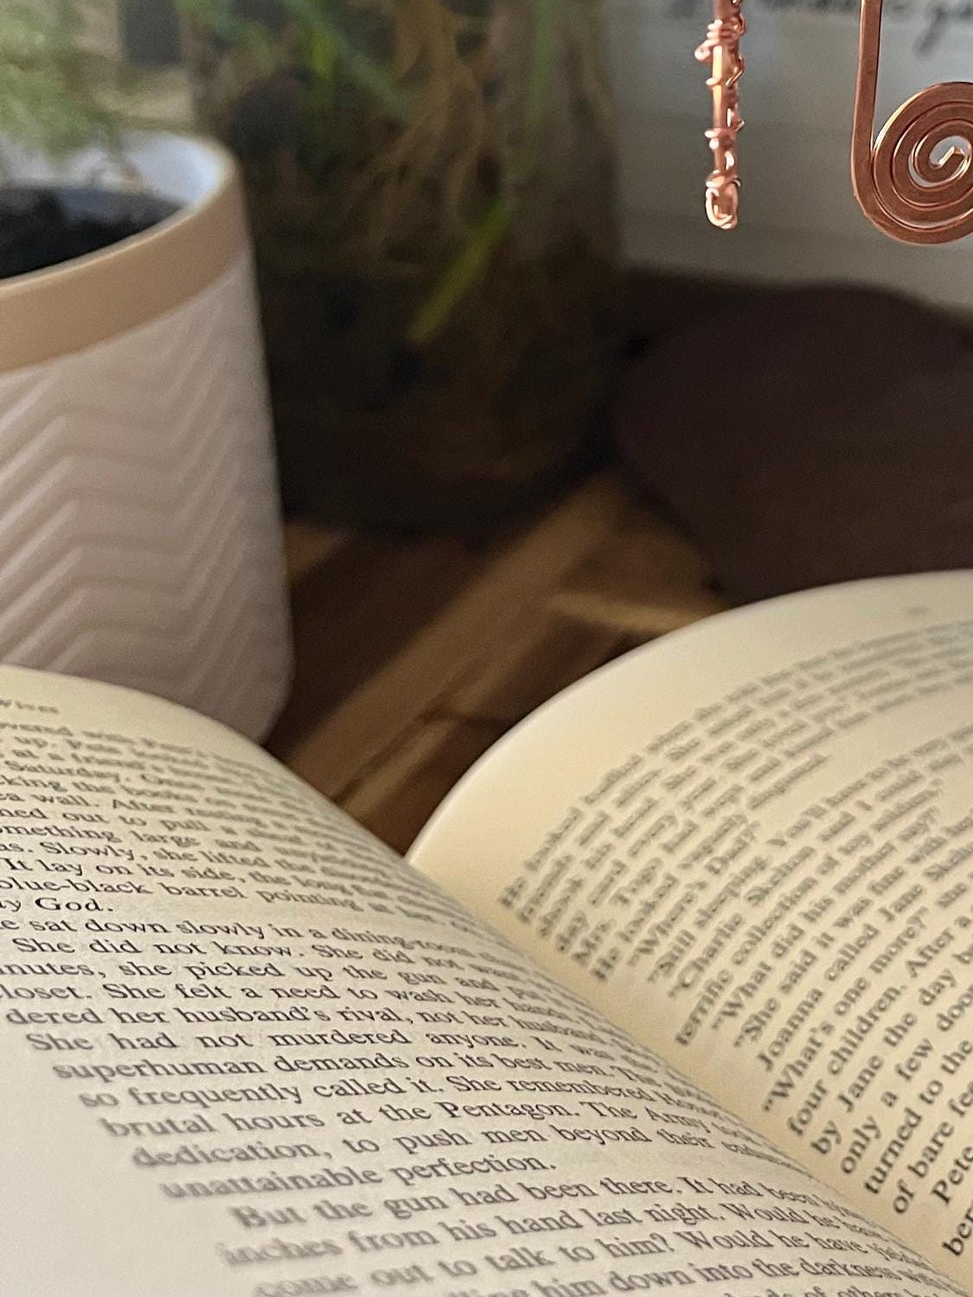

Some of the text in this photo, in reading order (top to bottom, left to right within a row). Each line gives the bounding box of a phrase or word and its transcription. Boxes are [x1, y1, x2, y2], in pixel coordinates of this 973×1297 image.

[40, 841, 148, 861] Slowly,
[35, 859, 245, 883] lay on its side,
[35, 897, 114, 912] God.
[159, 882, 364, 912] barrel pointing
[29, 918, 304, 939] sat down slowly in
[12, 938, 364, 960] She did not know. She
[118, 962, 447, 985] she picked up the gun
[102, 983, 501, 1009] She felt need to wash her
[6, 1006, 506, 1028] dered her rival, not her
[757, 988, 825, 1072] Joanna
[827, 984, 908, 1075] children.
[25, 1029, 527, 1051] She had not murdered anyone.
[53, 1053, 554, 1083] superhuman demands on best
[838, 1012, 918, 1112] Jane the
[127, 1076, 655, 1108] frequently called it. She remembered
[840, 1116, 881, 1174] only
[895, 1038, 934, 1081] few
[222, 1100, 712, 1134] hours at the Pentagon. Army
[131, 1125, 652, 1168] dedication, push men beyond
[864, 1107, 922, 1194] turned
[907, 1121, 955, 1179] bare
[162, 1155, 557, 1199] unattainable perfection.
[313, 1176, 764, 1220] the gun had been there. had
[348, 1203, 809, 1252] from his hand last night. Would
[485, 1230, 773, 1271] talk him? Would
[695, 1263, 754, 1282] into
[752, 1259, 801, 1277] the
[799, 1257, 902, 1281] darkness
